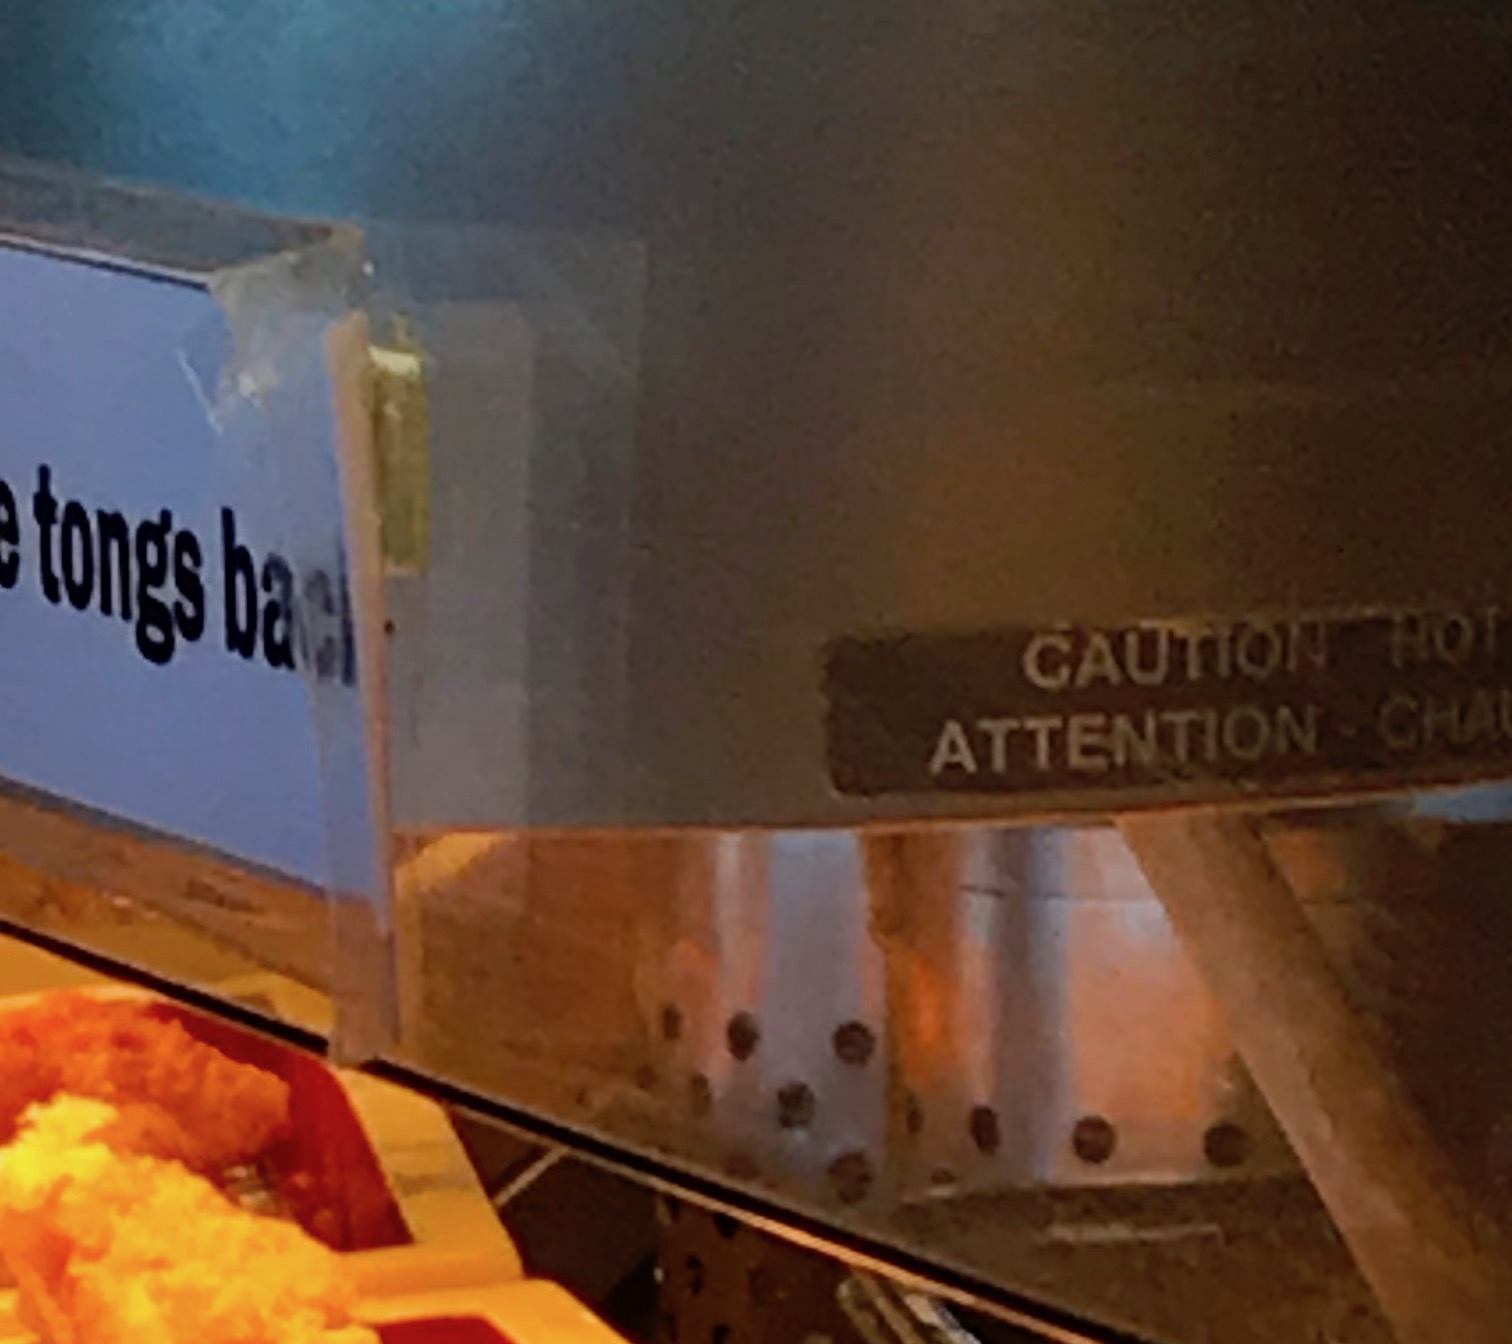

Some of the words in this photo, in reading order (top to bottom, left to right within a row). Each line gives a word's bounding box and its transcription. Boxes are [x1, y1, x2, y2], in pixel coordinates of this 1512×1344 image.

[32, 463, 206, 667] tongs
[1021, 616, 1328, 691] CAUTION
[928, 700, 1321, 777] ATTENTION
